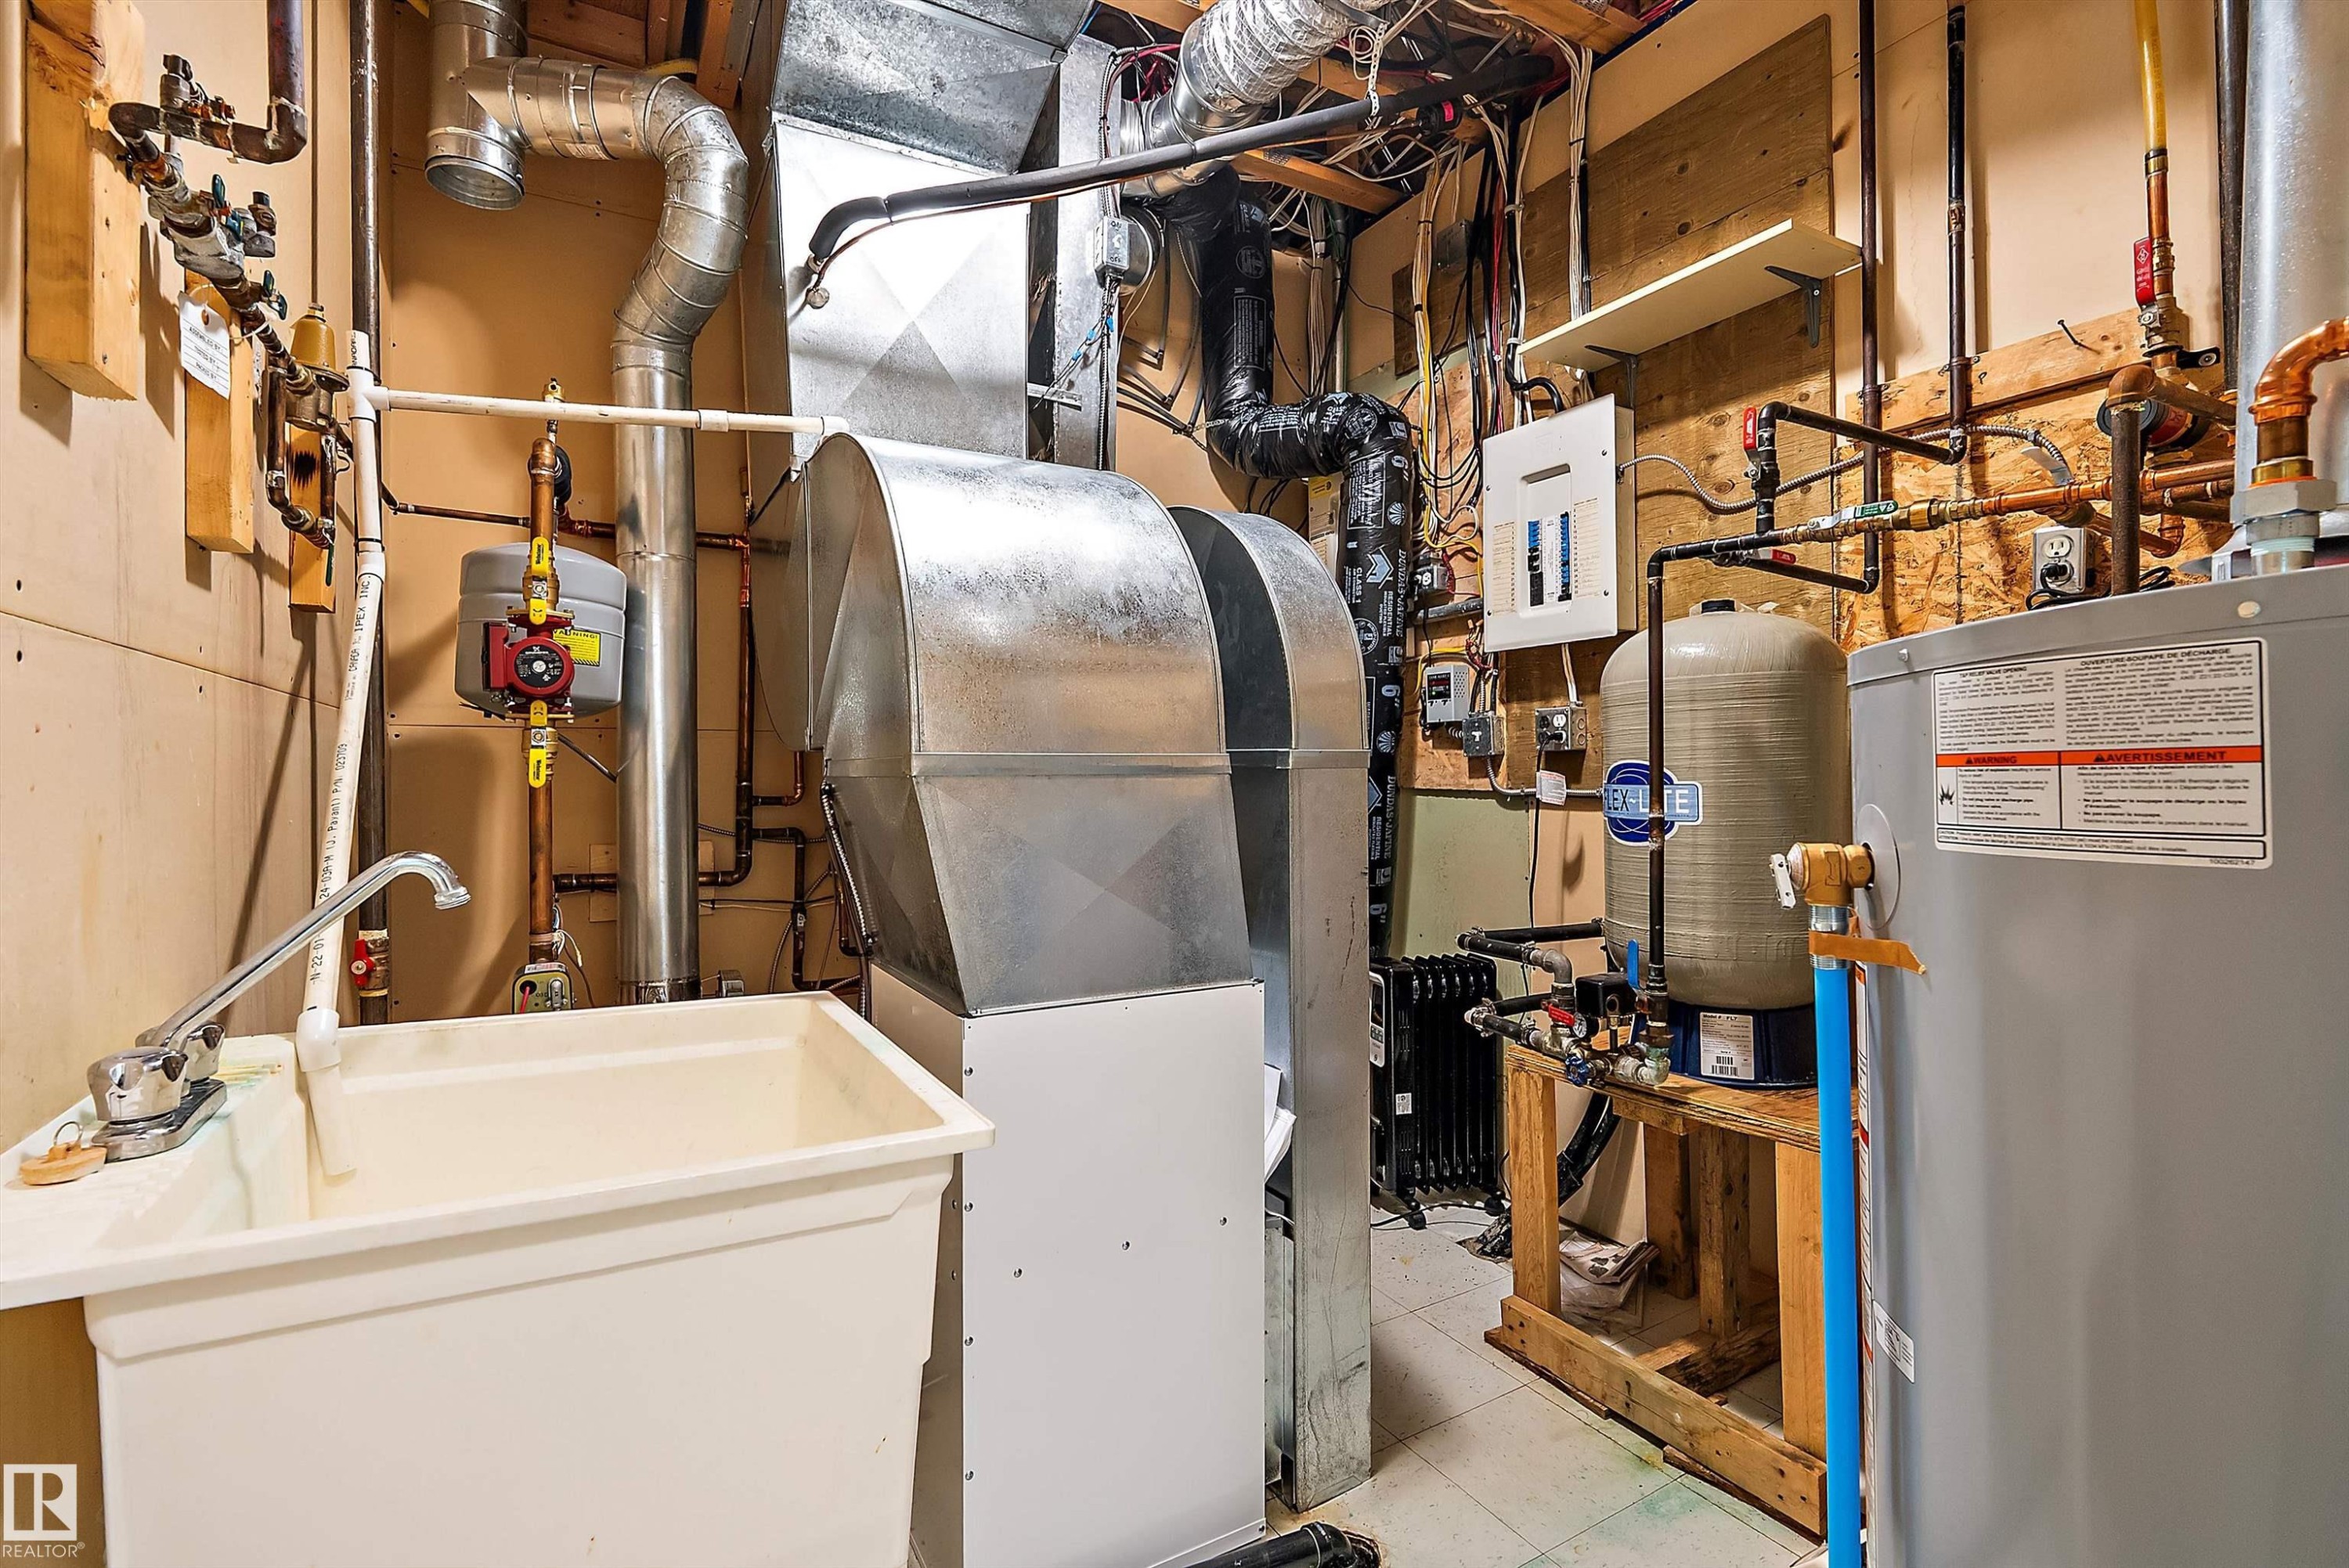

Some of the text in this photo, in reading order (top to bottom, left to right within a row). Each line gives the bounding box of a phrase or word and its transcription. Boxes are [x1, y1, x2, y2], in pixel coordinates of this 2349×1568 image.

[354, 575, 371, 632] IPEX INC.
[554, 629, 597, 639] ANING!
[1381, 684, 1401, 708] 6"
[335, 743, 348, 771] 023709
[2105, 752, 2226, 762] AVERTISSEMENT
